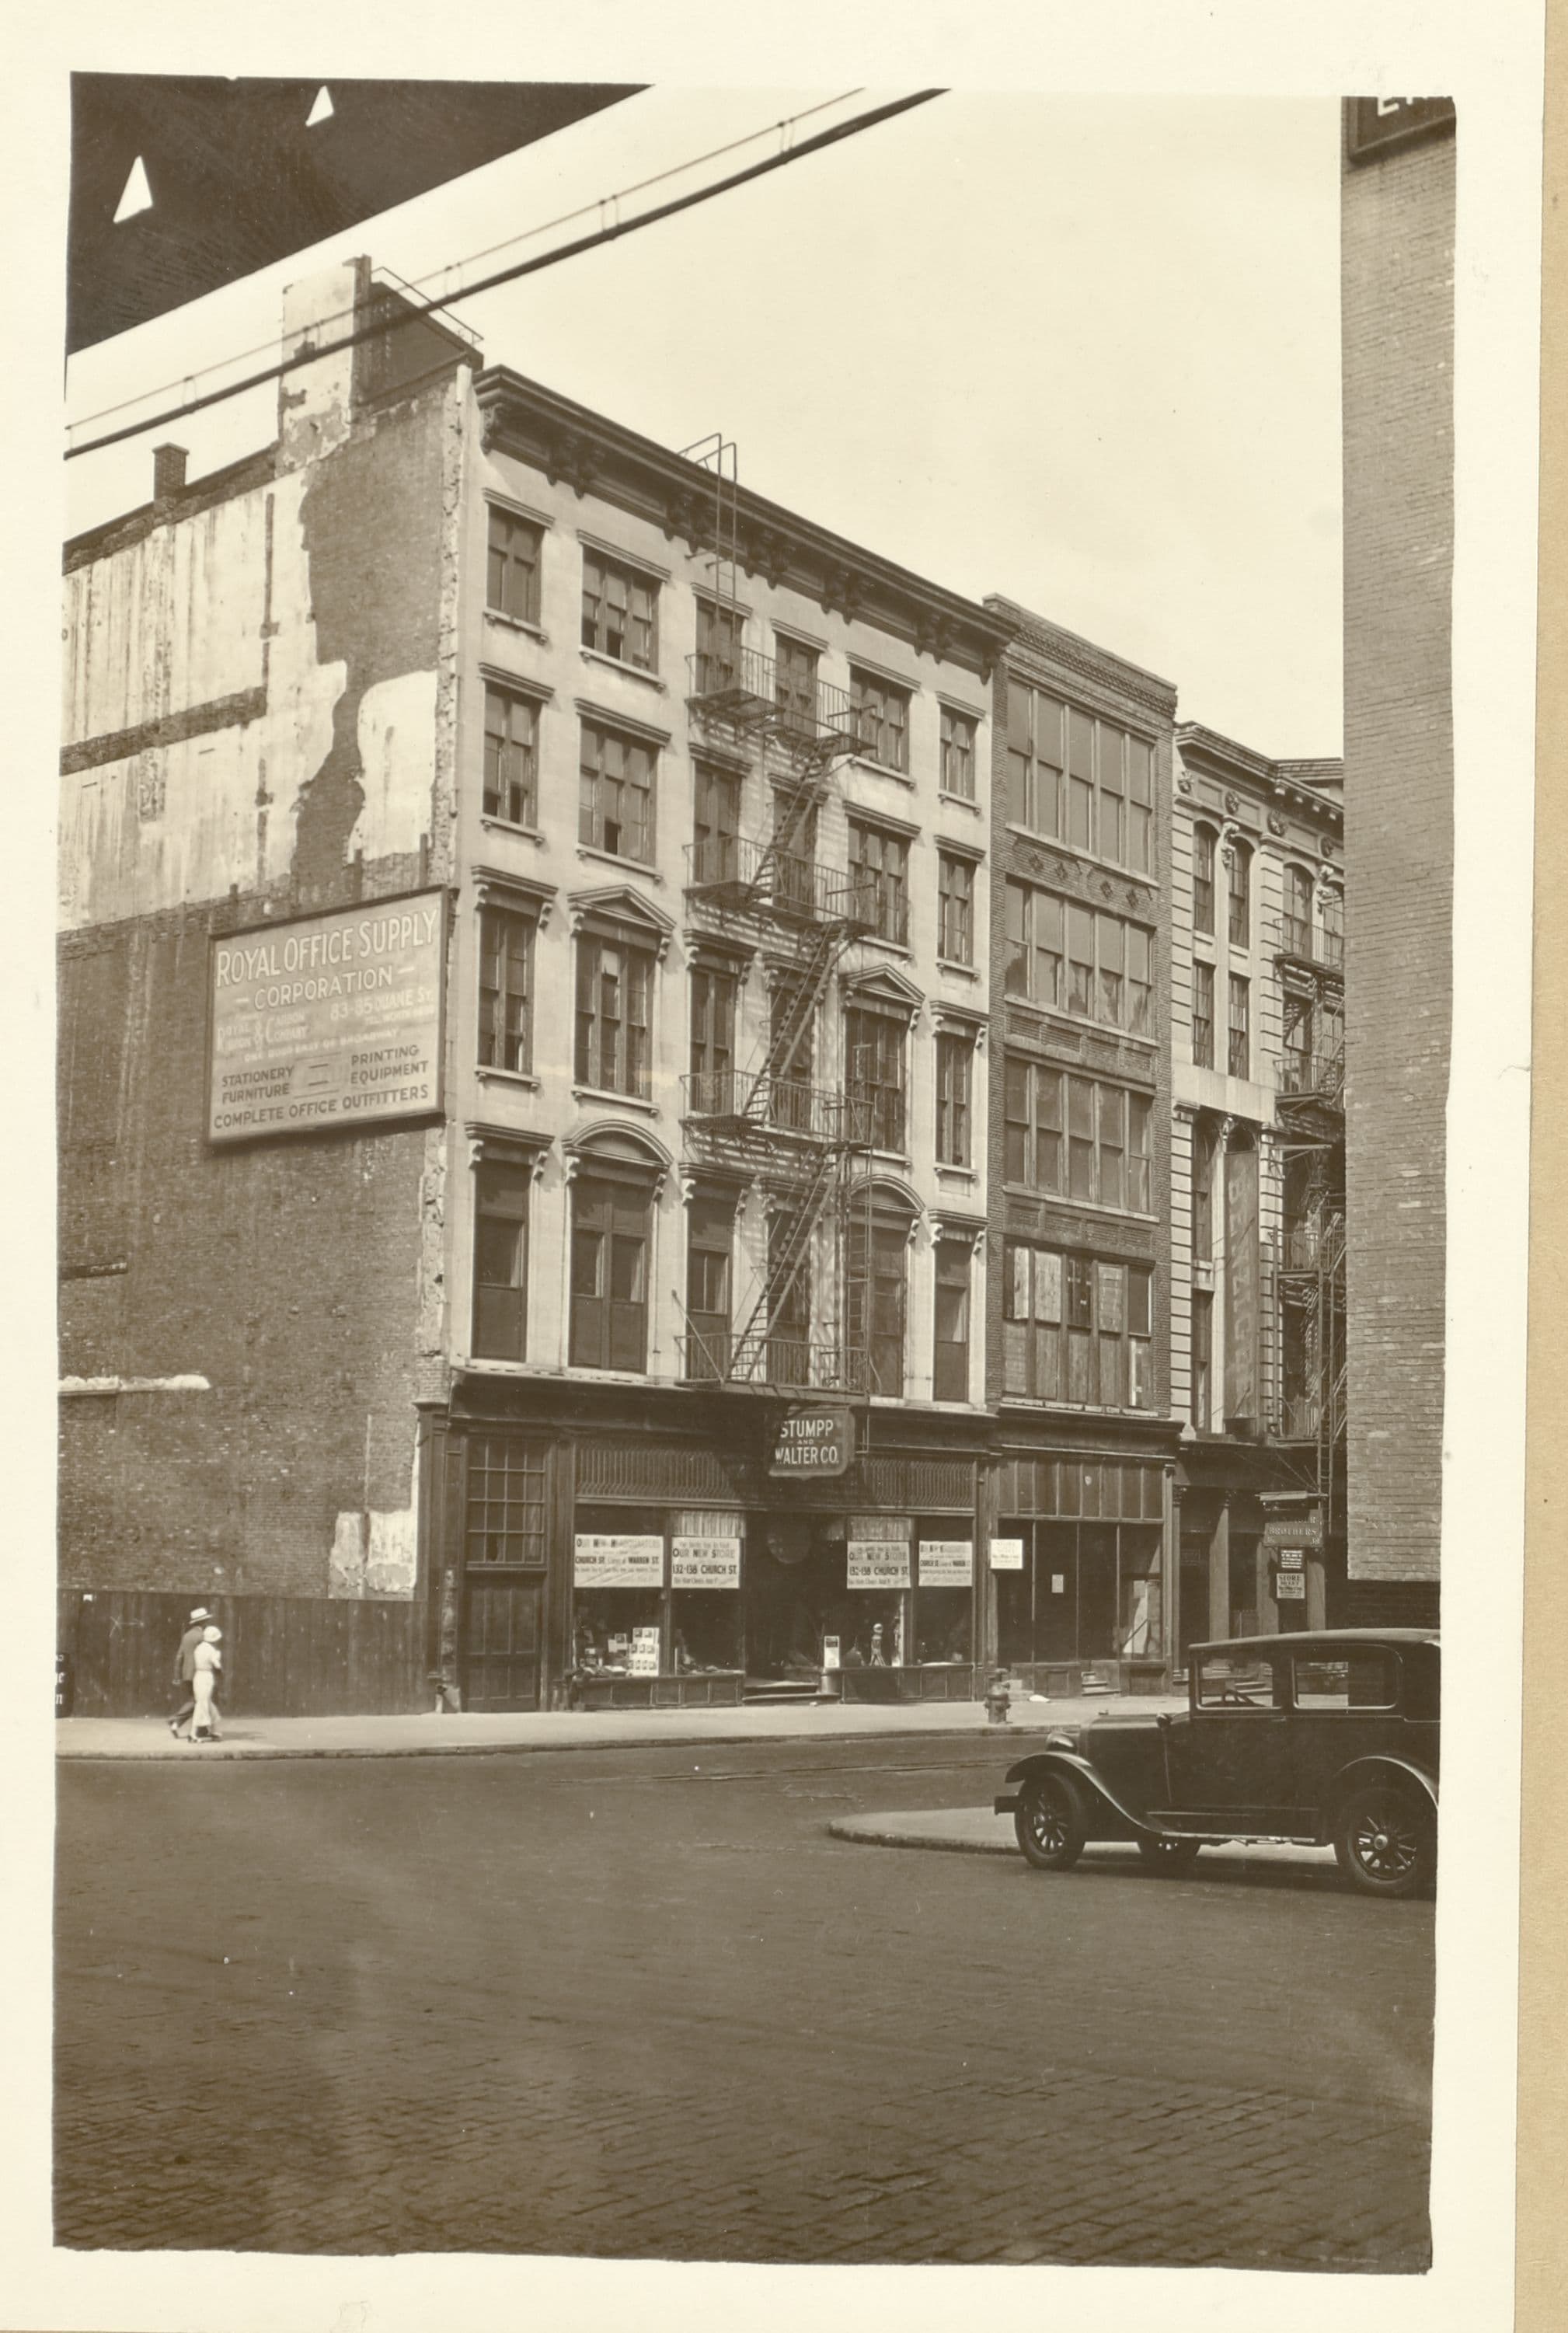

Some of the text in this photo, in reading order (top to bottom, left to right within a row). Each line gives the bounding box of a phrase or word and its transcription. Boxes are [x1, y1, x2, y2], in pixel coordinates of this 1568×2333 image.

[217, 909, 437, 988] ROYAL OFFICE SUPPLY
[254, 964, 393, 1010] CORPORATION
[351, 1044, 420, 1066] PRINTING
[222, 1065, 295, 1087] STATIONERY
[350, 1061, 429, 1085] EQUIPMENT
[222, 1083, 291, 1104] FURNITURE
[214, 1084, 429, 1129] COMPLETE OFFICE OUTFITTERS
[780, 1419, 834, 1439] STUMPP
[775, 1445, 839, 1466] WALTER CO.
[1269, 1527, 1318, 1536] BROTHERS
[575, 1556, 597, 1564] CHURCH
[628, 1556, 650, 1564] WARREN
[673, 1547, 735, 1559] OUR NEW STORE
[672, 1564, 698, 1575] 132-138
[701, 1564, 727, 1575] CHURCH
[873, 1566, 899, 1575] CHURCH
